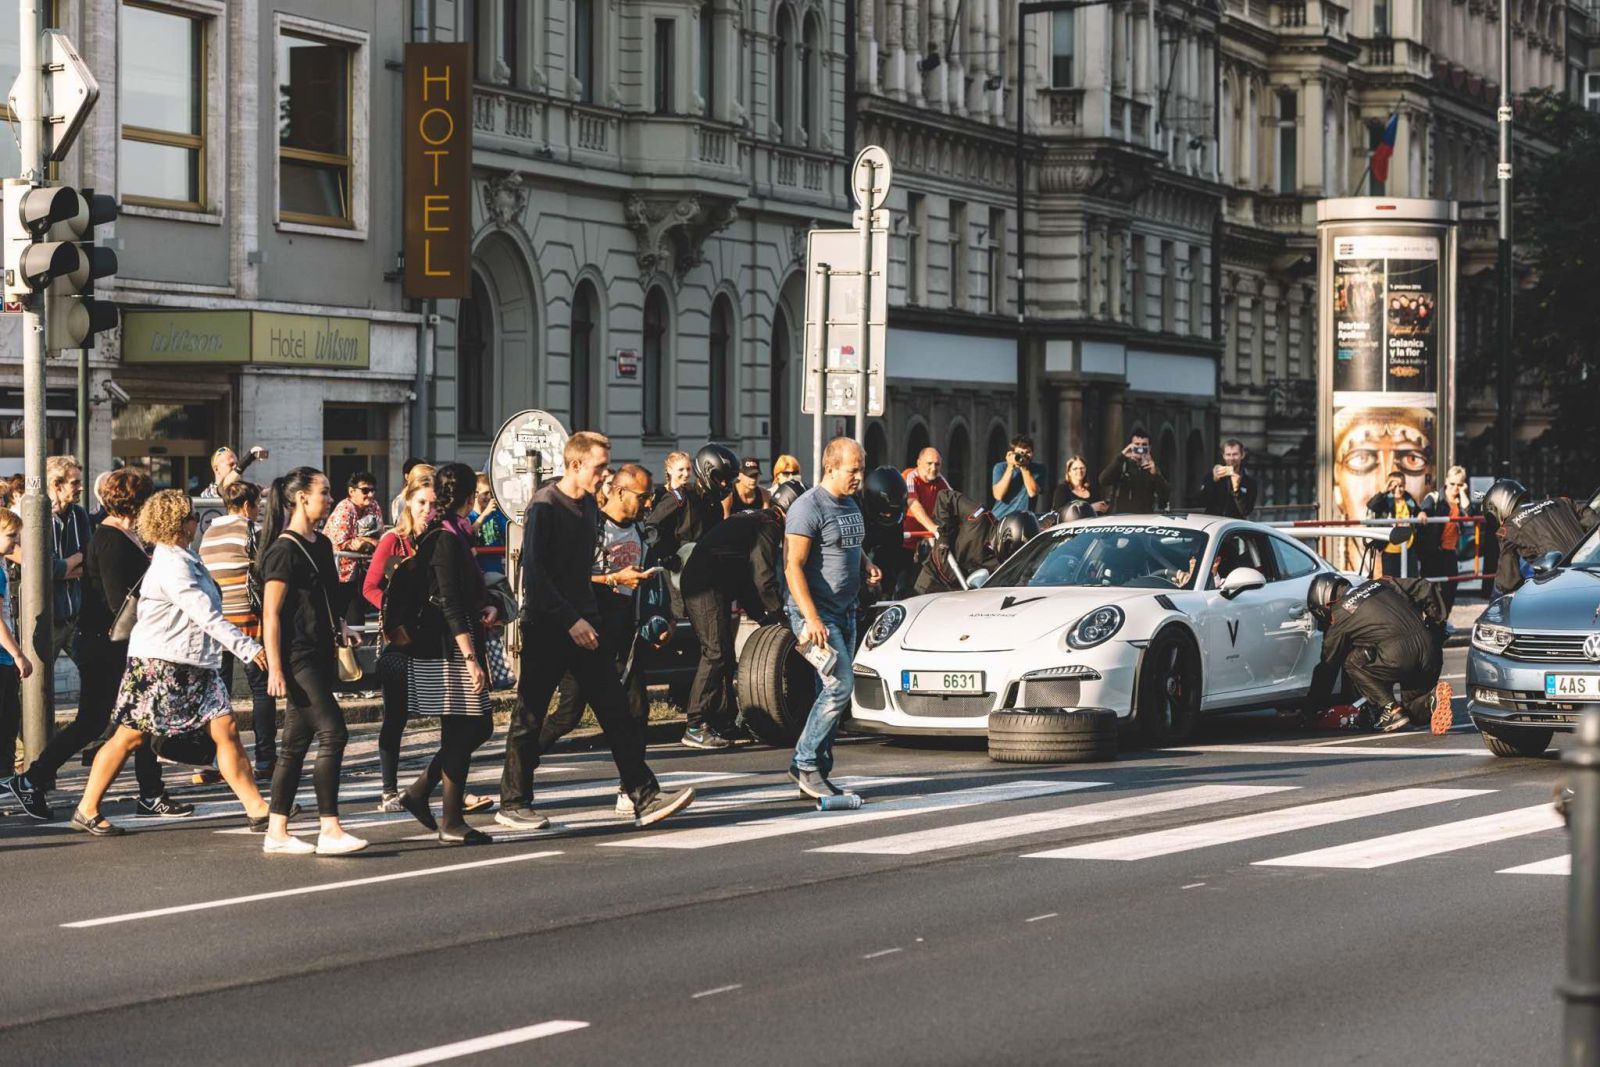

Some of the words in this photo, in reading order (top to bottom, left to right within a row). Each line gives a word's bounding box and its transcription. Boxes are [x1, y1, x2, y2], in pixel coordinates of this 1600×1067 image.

[419, 65, 453, 276] HOTEL
[270, 328, 306, 359] Hotel
[315, 319, 359, 361] Wilson
[1052, 525, 1182, 538] #AdvantageCars
[912, 673, 919, 689] A
[943, 673, 975, 689] 6631
[1559, 677, 1586, 694] 4AS
[154, 803, 170, 813] N
